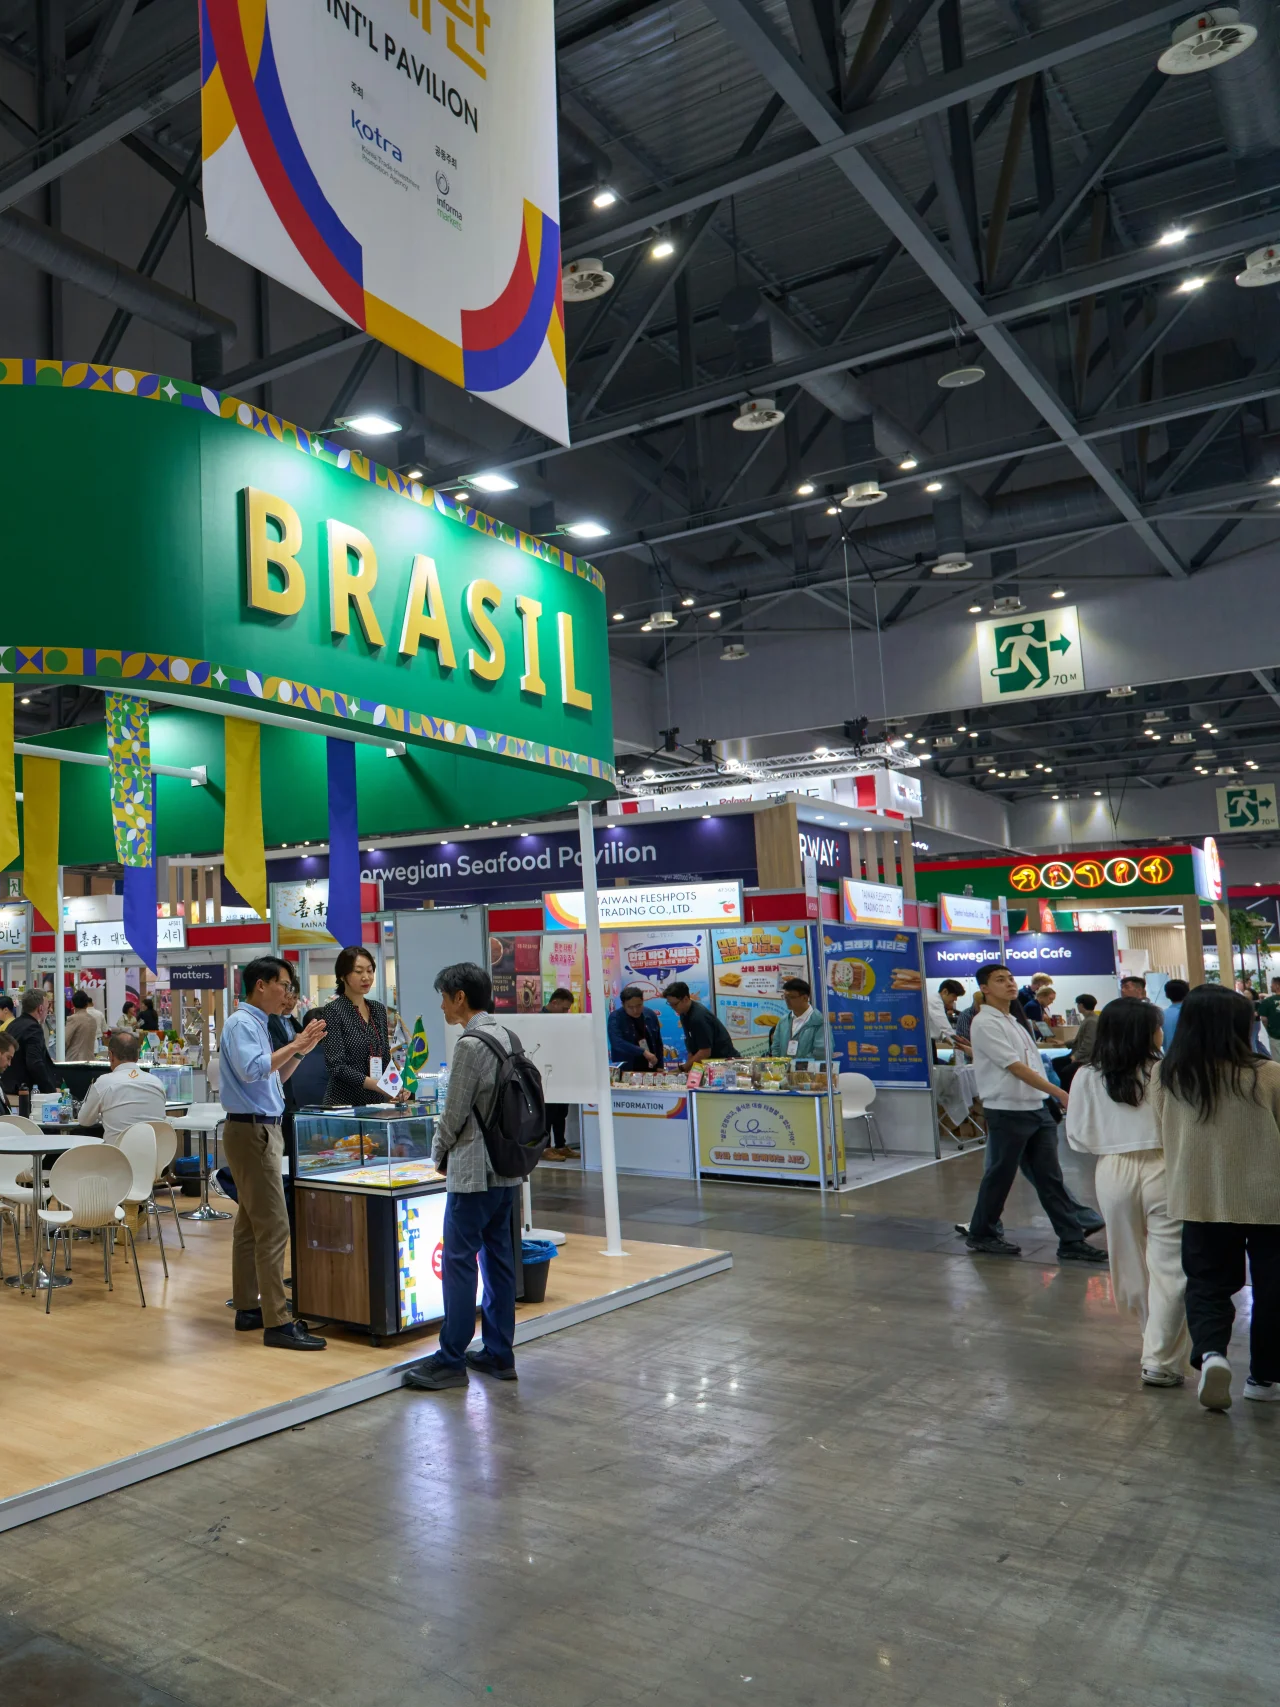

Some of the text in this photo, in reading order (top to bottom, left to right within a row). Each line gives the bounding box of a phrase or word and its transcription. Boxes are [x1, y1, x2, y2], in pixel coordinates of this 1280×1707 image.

[326, 0, 478, 133] INT'L PAVILION
[351, 109, 402, 163] kotra
[390, 173, 408, 192] Agency
[437, 195, 462, 221] informa
[437, 208, 462, 232] markets
[244, 486, 593, 711] BRASIL
[1053, 673, 1068, 686] 70
[799, 833, 835, 866] RWAY
[360, 860, 452, 885] orwegian
[457, 847, 551, 875] Seafood
[597, 892, 697, 905] TAIWAN FLESHPOTS
[600, 906, 646, 917] TRADING
[163, 928, 181, 943] 시티
[844, 940, 873, 952] 크래커
[876, 941, 907, 953] 시리즈
[1006, 948, 1037, 960] Food
[1041, 947, 1072, 959] Cafe
[173, 971, 212, 979] matters.
[613, 1101, 664, 1110] INFORMATION
